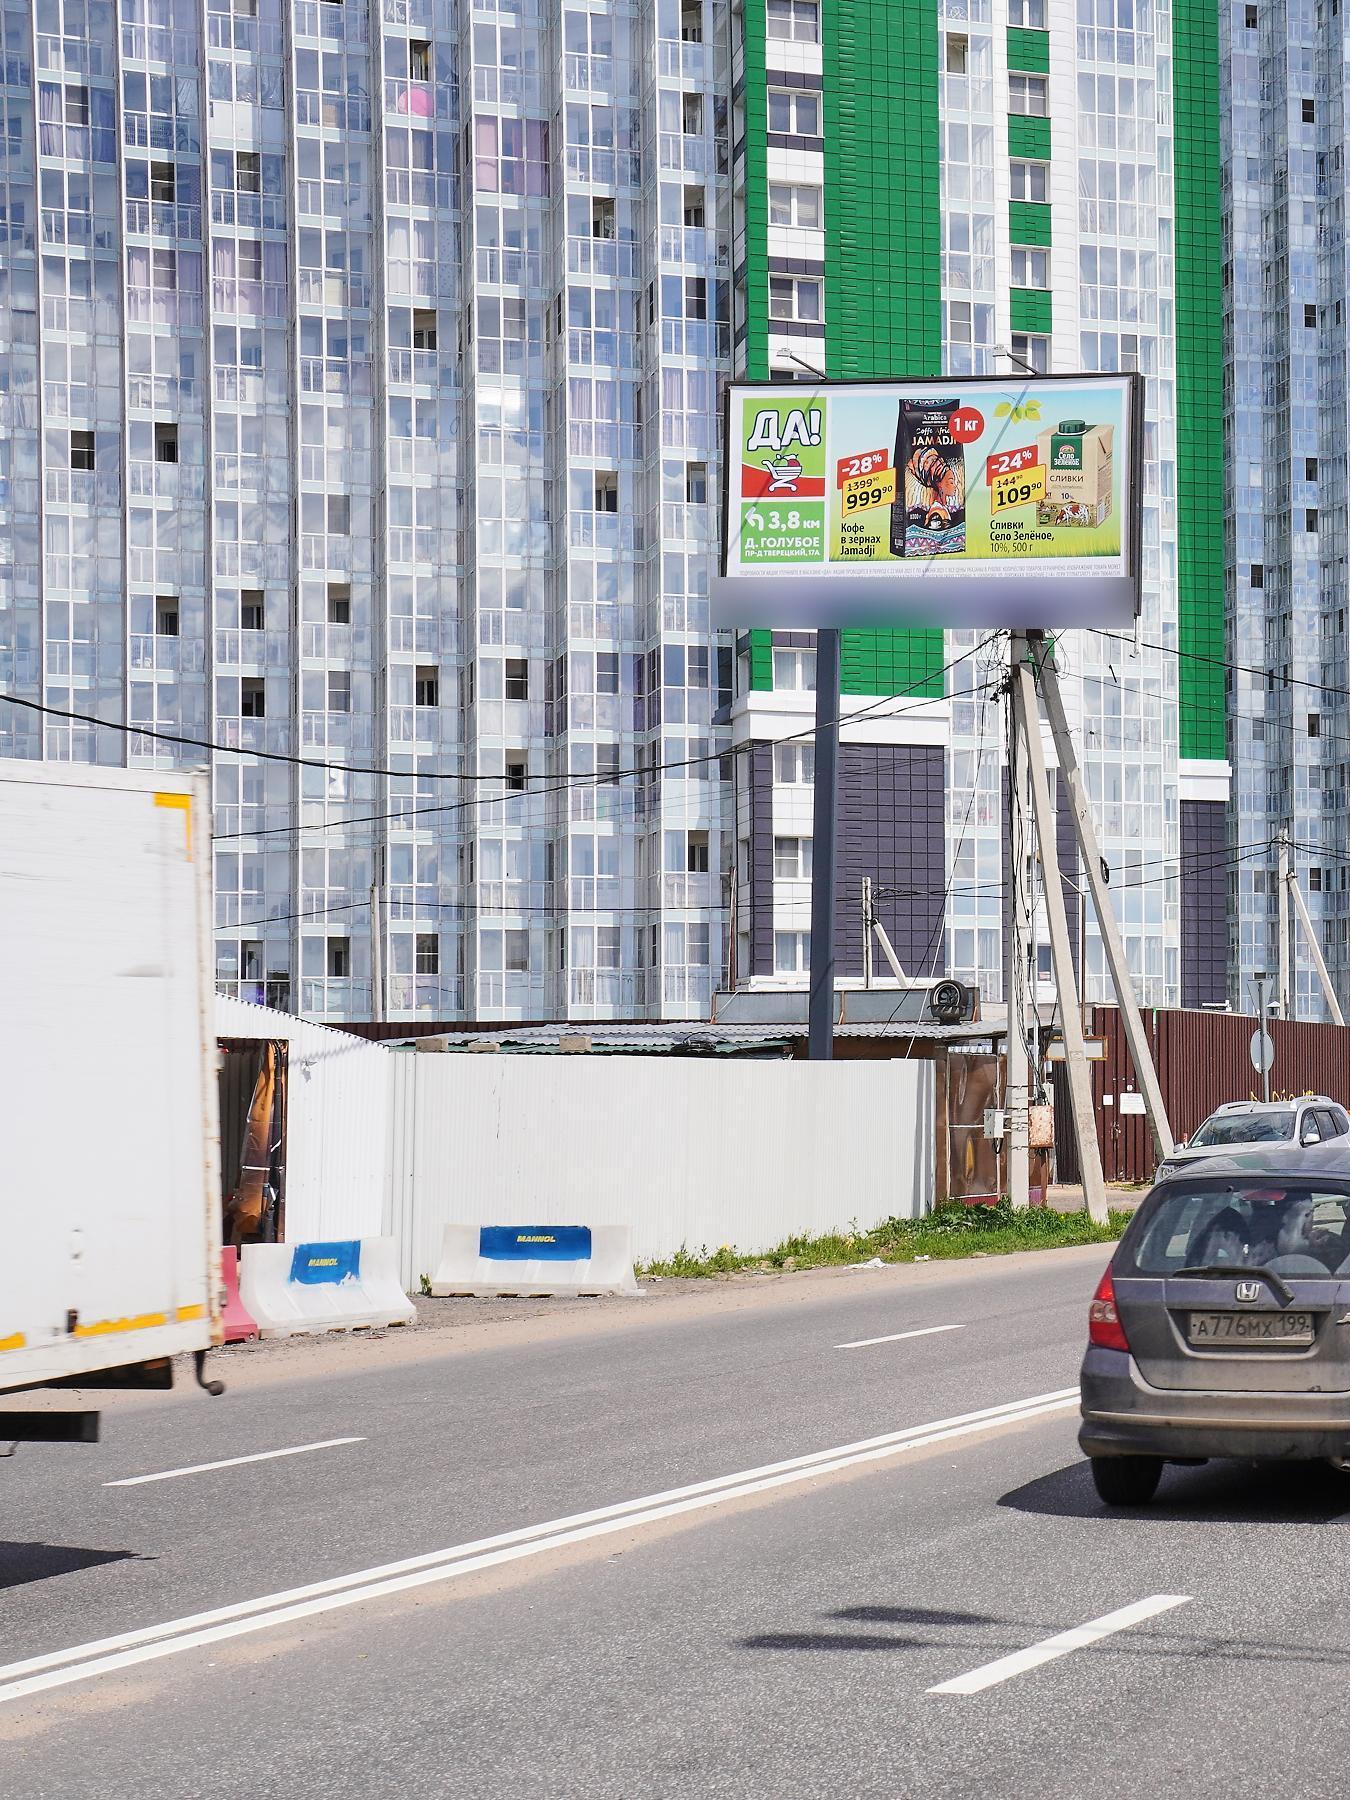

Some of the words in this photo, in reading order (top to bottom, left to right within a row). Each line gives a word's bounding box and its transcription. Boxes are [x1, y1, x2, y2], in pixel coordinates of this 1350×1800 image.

[747, 409, 821, 451] ДА!
[954, 417, 960, 431] 1
[964, 420, 978, 431] кг
[768, 511, 800, 532] 3,8
[990, 520, 1024, 530] Сливки
[841, 523, 865, 534] Кофе
[849, 536, 881, 545] зернах
[990, 531, 1011, 541] Село
[1014, 530, 1054, 542] Зелёное,
[745, 537, 758, 549] Д.
[760, 537, 820, 548] ГОЛУБОЕ
[1013, 543, 1027, 552] 500
[840, 545, 875, 557] Jamadji
[516, 1235, 556, 1243] MANNOL
[1278, 1315, 1307, 1331] 199
